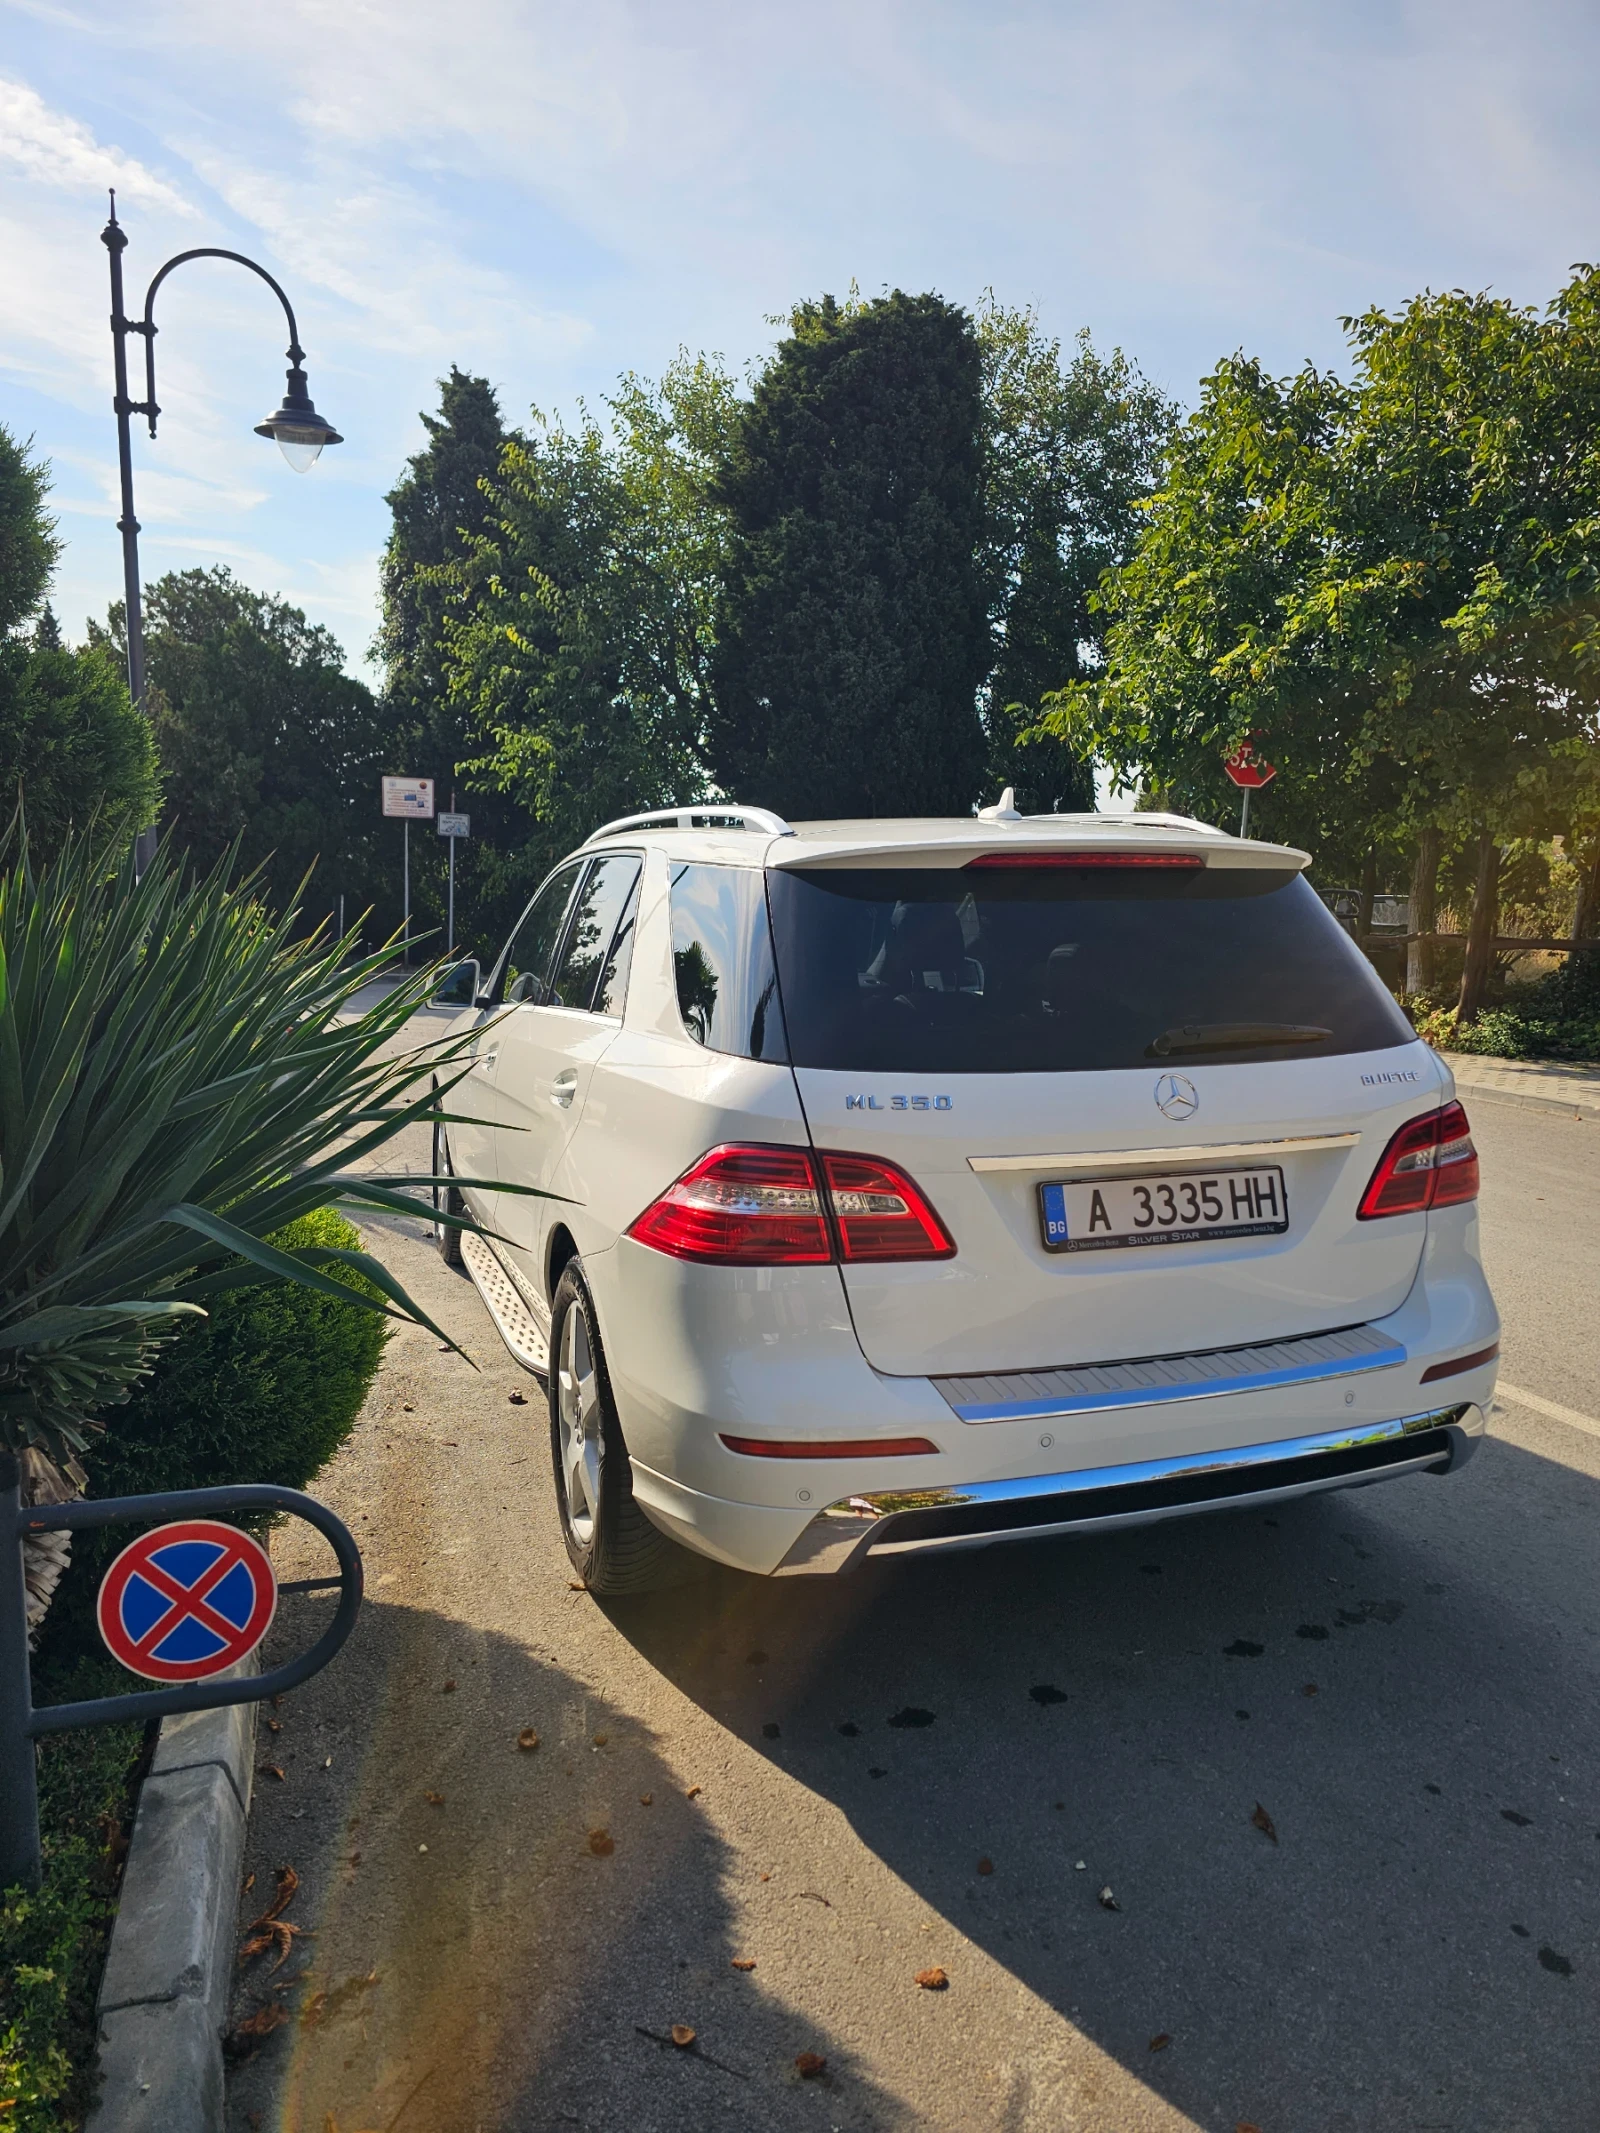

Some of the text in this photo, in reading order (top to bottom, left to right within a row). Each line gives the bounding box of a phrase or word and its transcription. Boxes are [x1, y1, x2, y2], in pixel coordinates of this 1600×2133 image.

[1361, 1071, 1420, 1086] BLUETEC
[845, 1094, 953, 1110] ML 350
[1089, 1176, 1278, 1232] A 3335 HH
[1048, 1221, 1066, 1234] BG
[1208, 1224, 1275, 1237] www.mercedes-benz.bg
[1078, 1239, 1119, 1249] Mercedes-Benz
